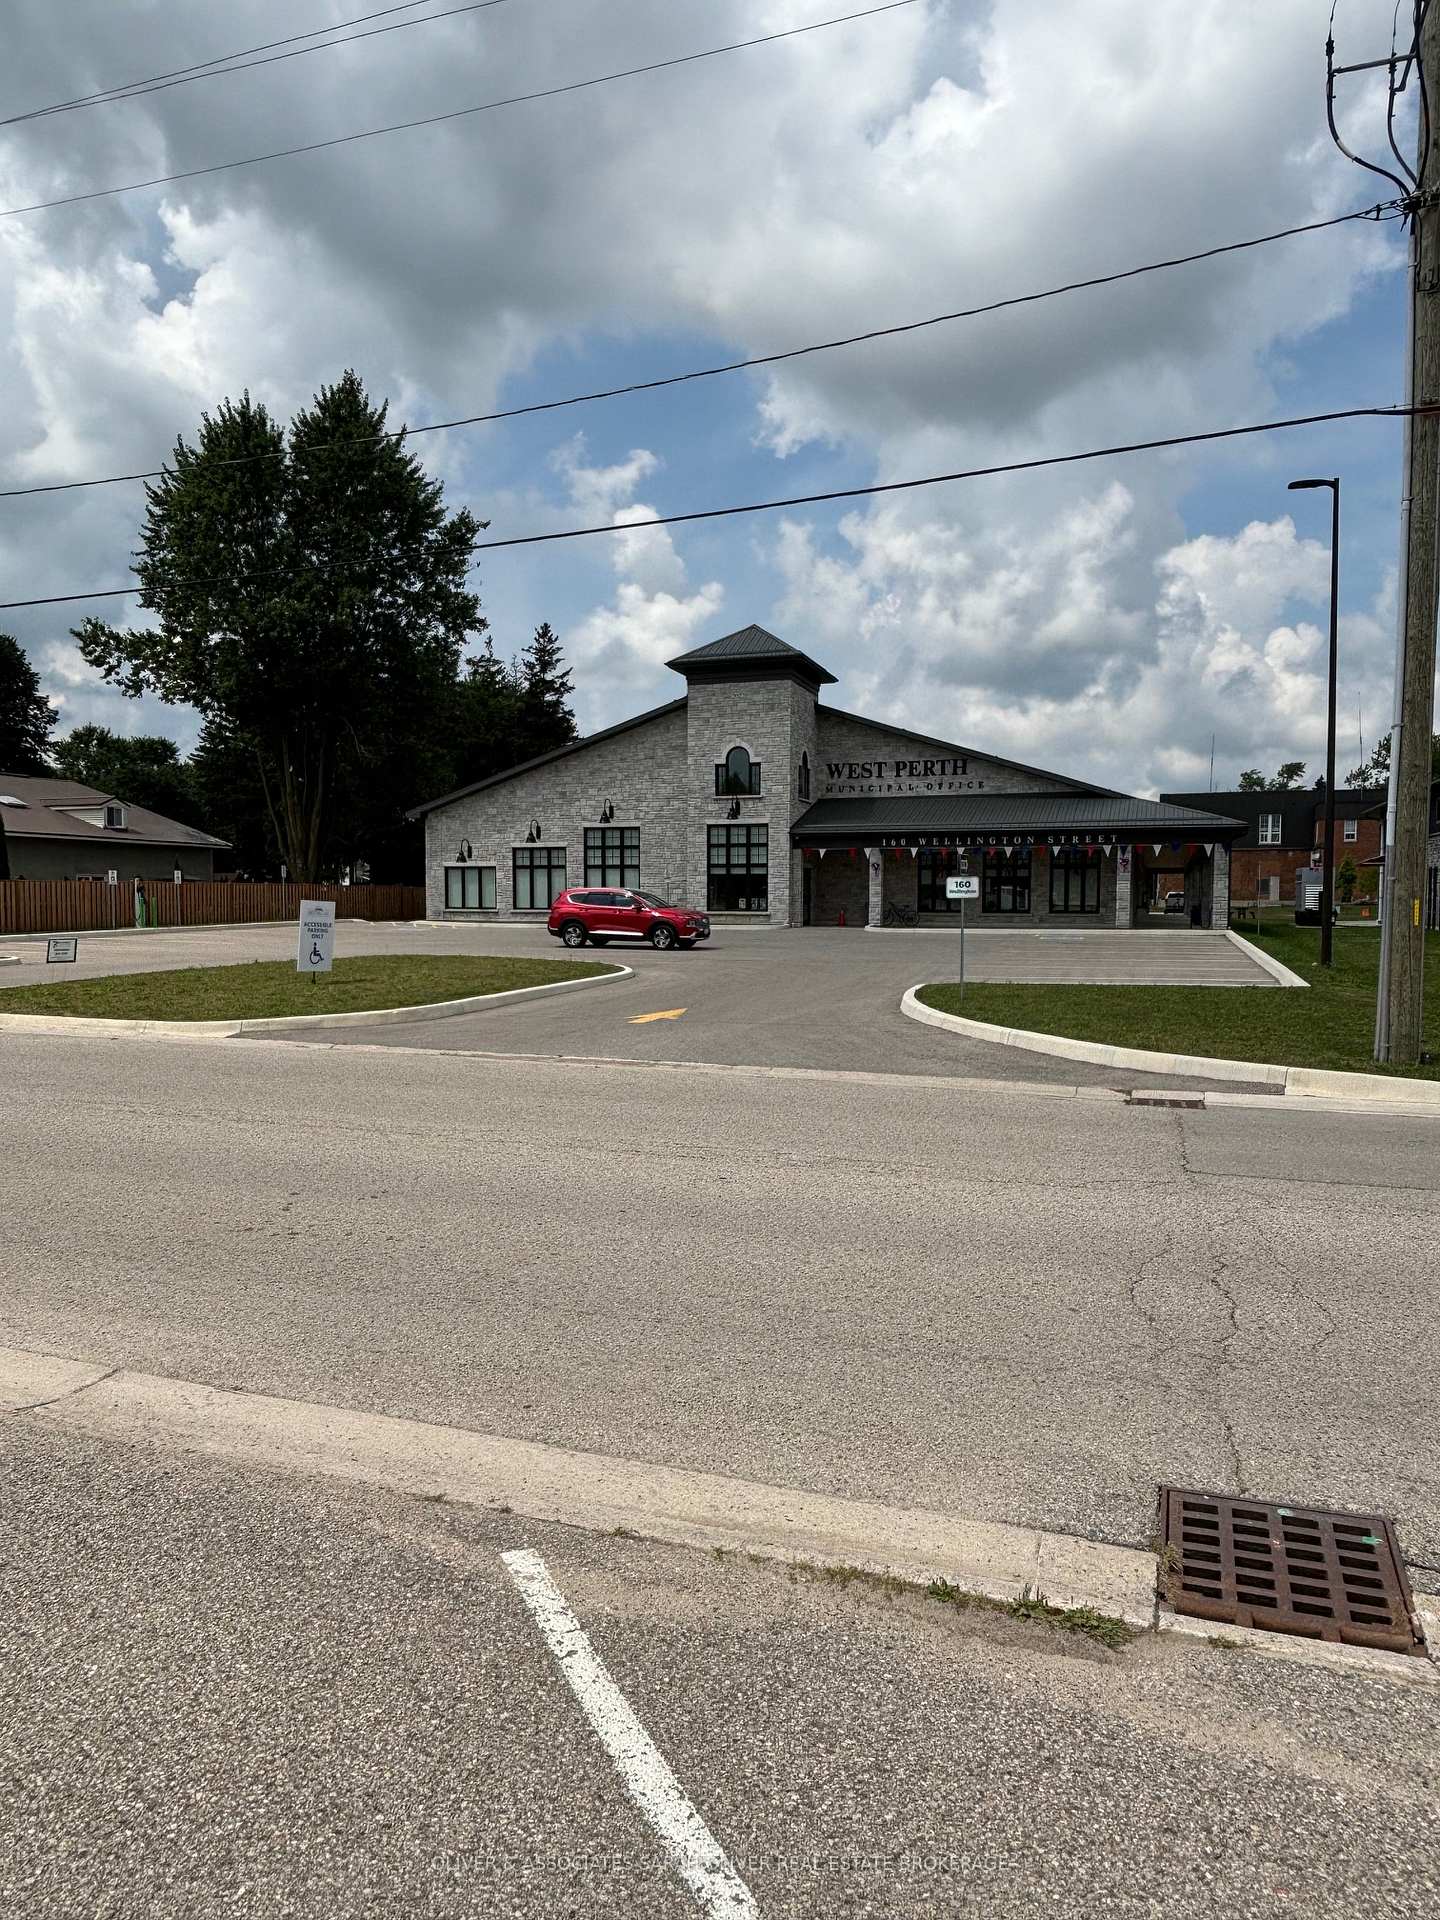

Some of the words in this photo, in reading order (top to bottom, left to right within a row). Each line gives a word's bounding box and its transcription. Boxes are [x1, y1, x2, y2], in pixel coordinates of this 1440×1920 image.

[826, 762, 887, 779] WEST
[894, 759, 968, 778] PERTH
[825, 783, 914, 793] MUNICIPAL
[926, 781, 985, 790] OFFICE
[882, 838, 907, 846] 160
[918, 835, 1035, 846] WELLINGTON
[1047, 834, 1118, 844] STREET
